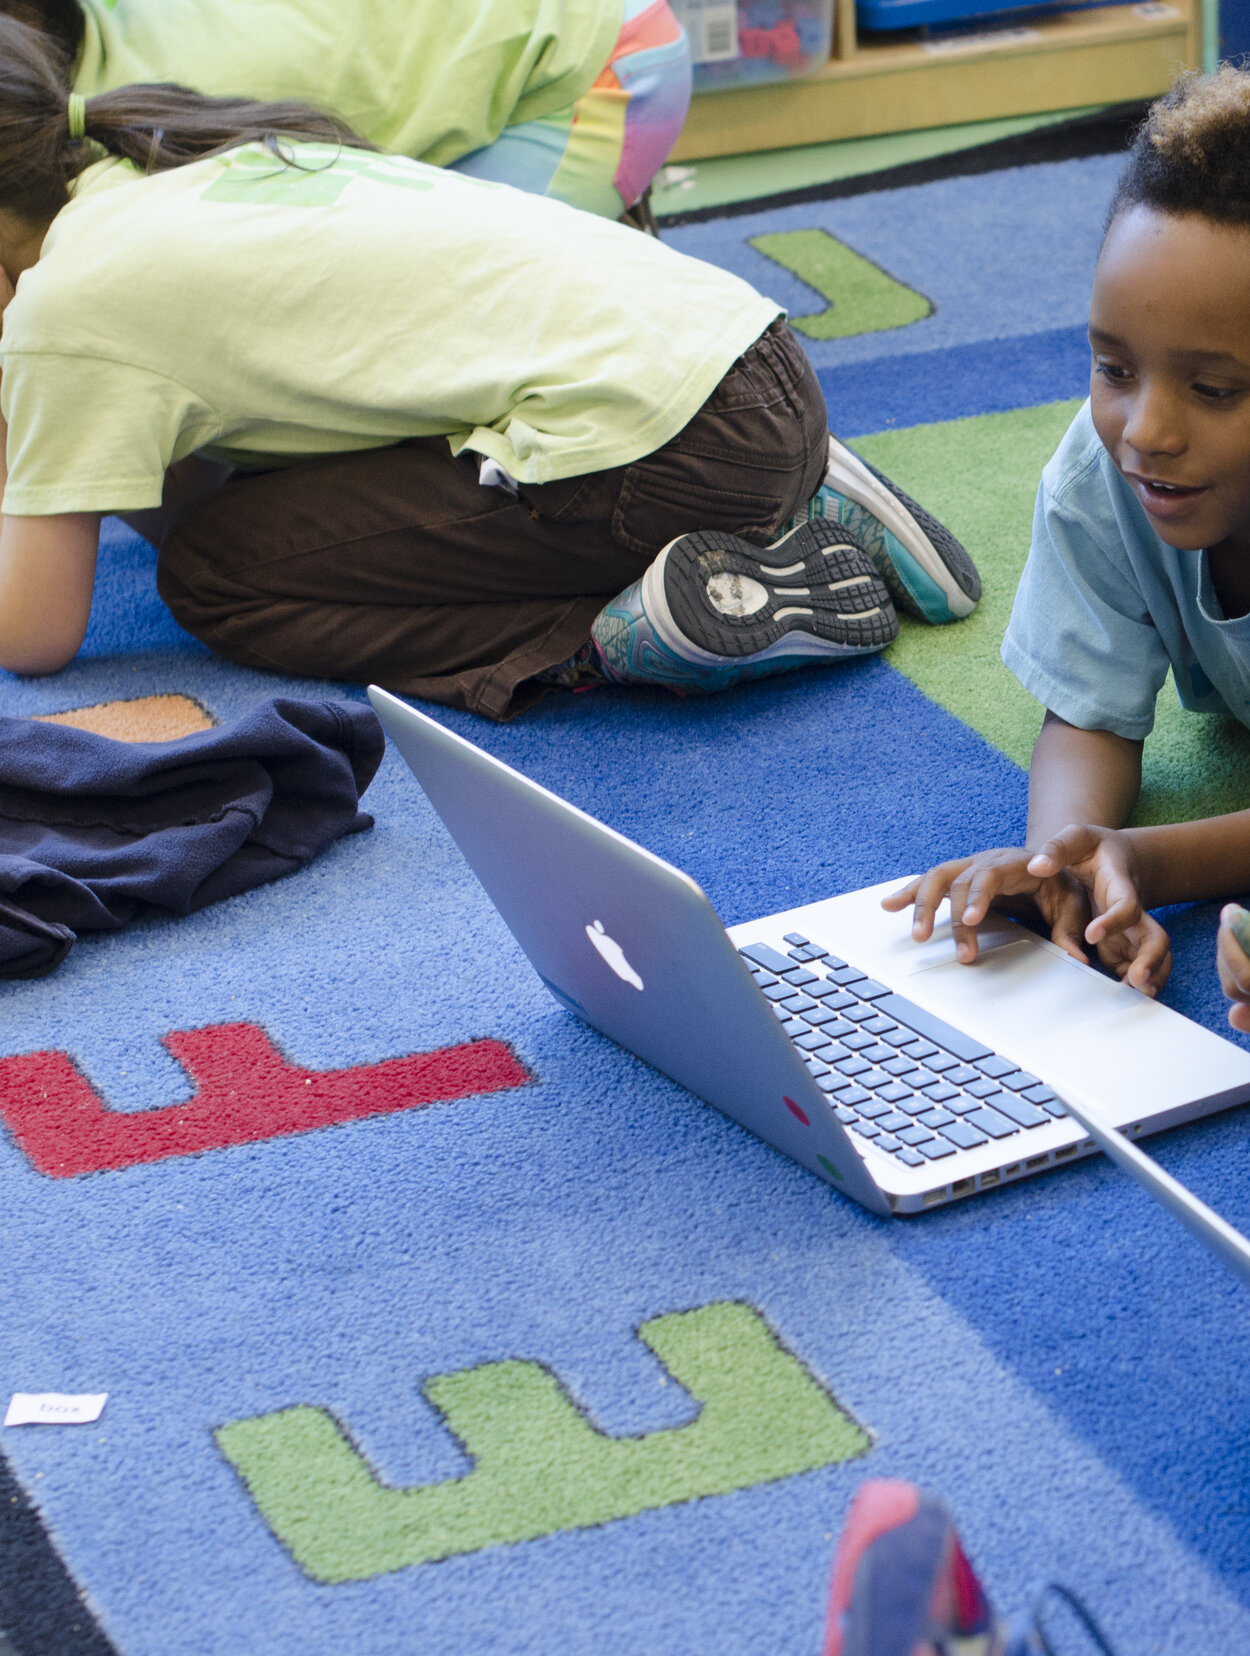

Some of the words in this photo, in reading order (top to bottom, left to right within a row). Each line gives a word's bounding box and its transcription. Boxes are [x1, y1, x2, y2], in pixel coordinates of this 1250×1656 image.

[0, 1020, 536, 1179] F
[39, 1402, 82, 1414] box
[214, 1299, 873, 1584] E
